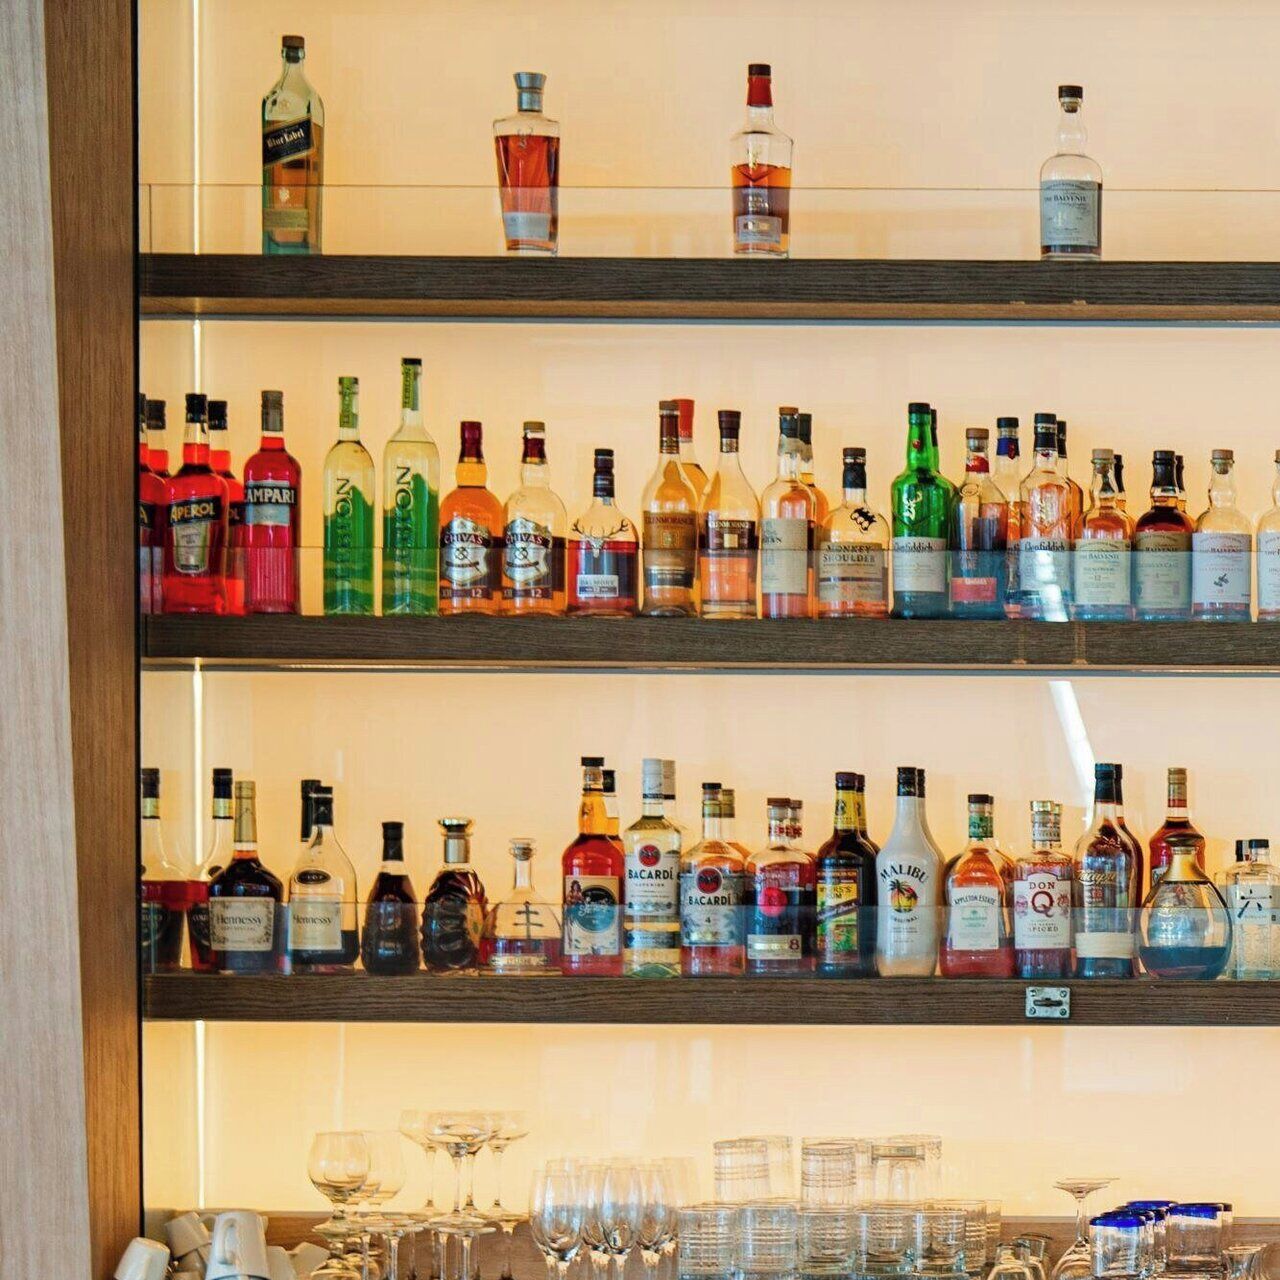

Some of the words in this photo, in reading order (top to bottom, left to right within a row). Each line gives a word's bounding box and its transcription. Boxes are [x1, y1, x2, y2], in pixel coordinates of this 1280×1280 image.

[170, 502, 216, 523] APEROL
[444, 533, 484, 546] CHIVAS
[505, 533, 544, 546] CHIVAS
[471, 588, 483, 598] 12
[531, 588, 542, 598] 12
[628, 866, 674, 880] BACARDÍ
[880, 863, 929, 884] MALIBU
[1028, 881, 1056, 890] DON
[688, 893, 733, 907] BACARDÍ
[1031, 890, 1055, 919] Q
[216, 913, 263, 928] Hennessy
[789, 938, 800, 951] 8
